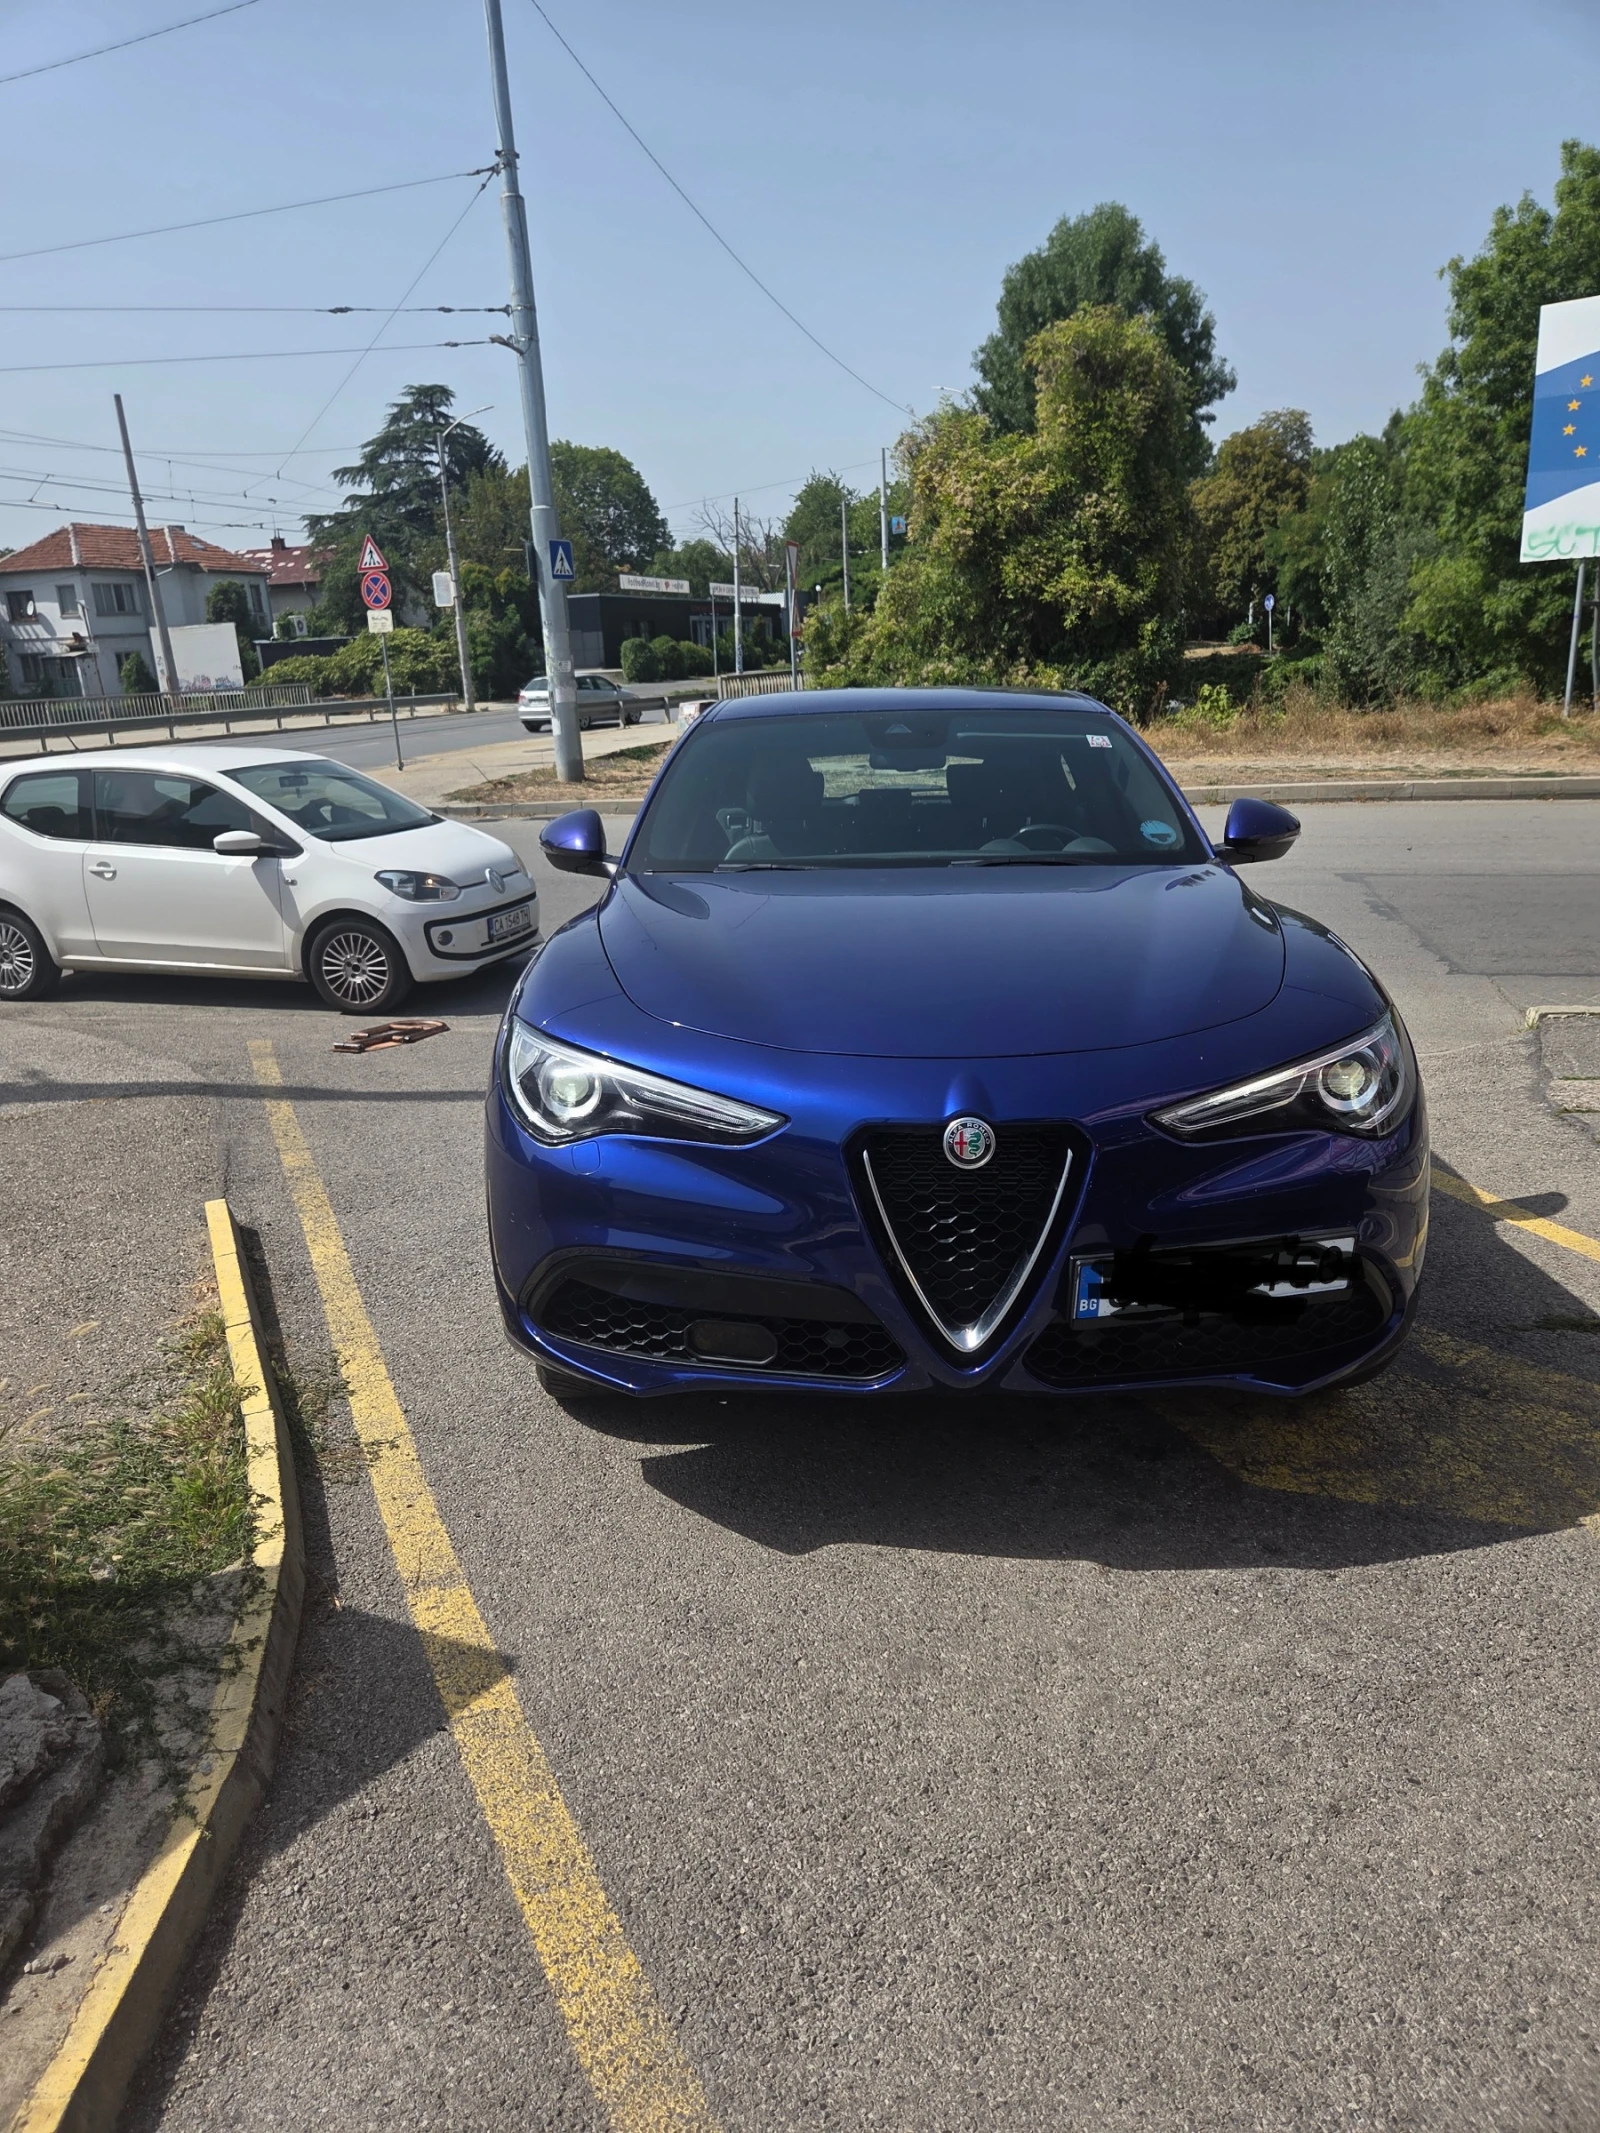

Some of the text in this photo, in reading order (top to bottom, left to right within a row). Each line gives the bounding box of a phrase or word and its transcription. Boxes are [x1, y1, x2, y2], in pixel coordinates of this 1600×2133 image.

[494, 918, 505, 933] CA
[948, 1122, 991, 1145] ALFA ROMEO
[1079, 1298, 1098, 1312] BG
